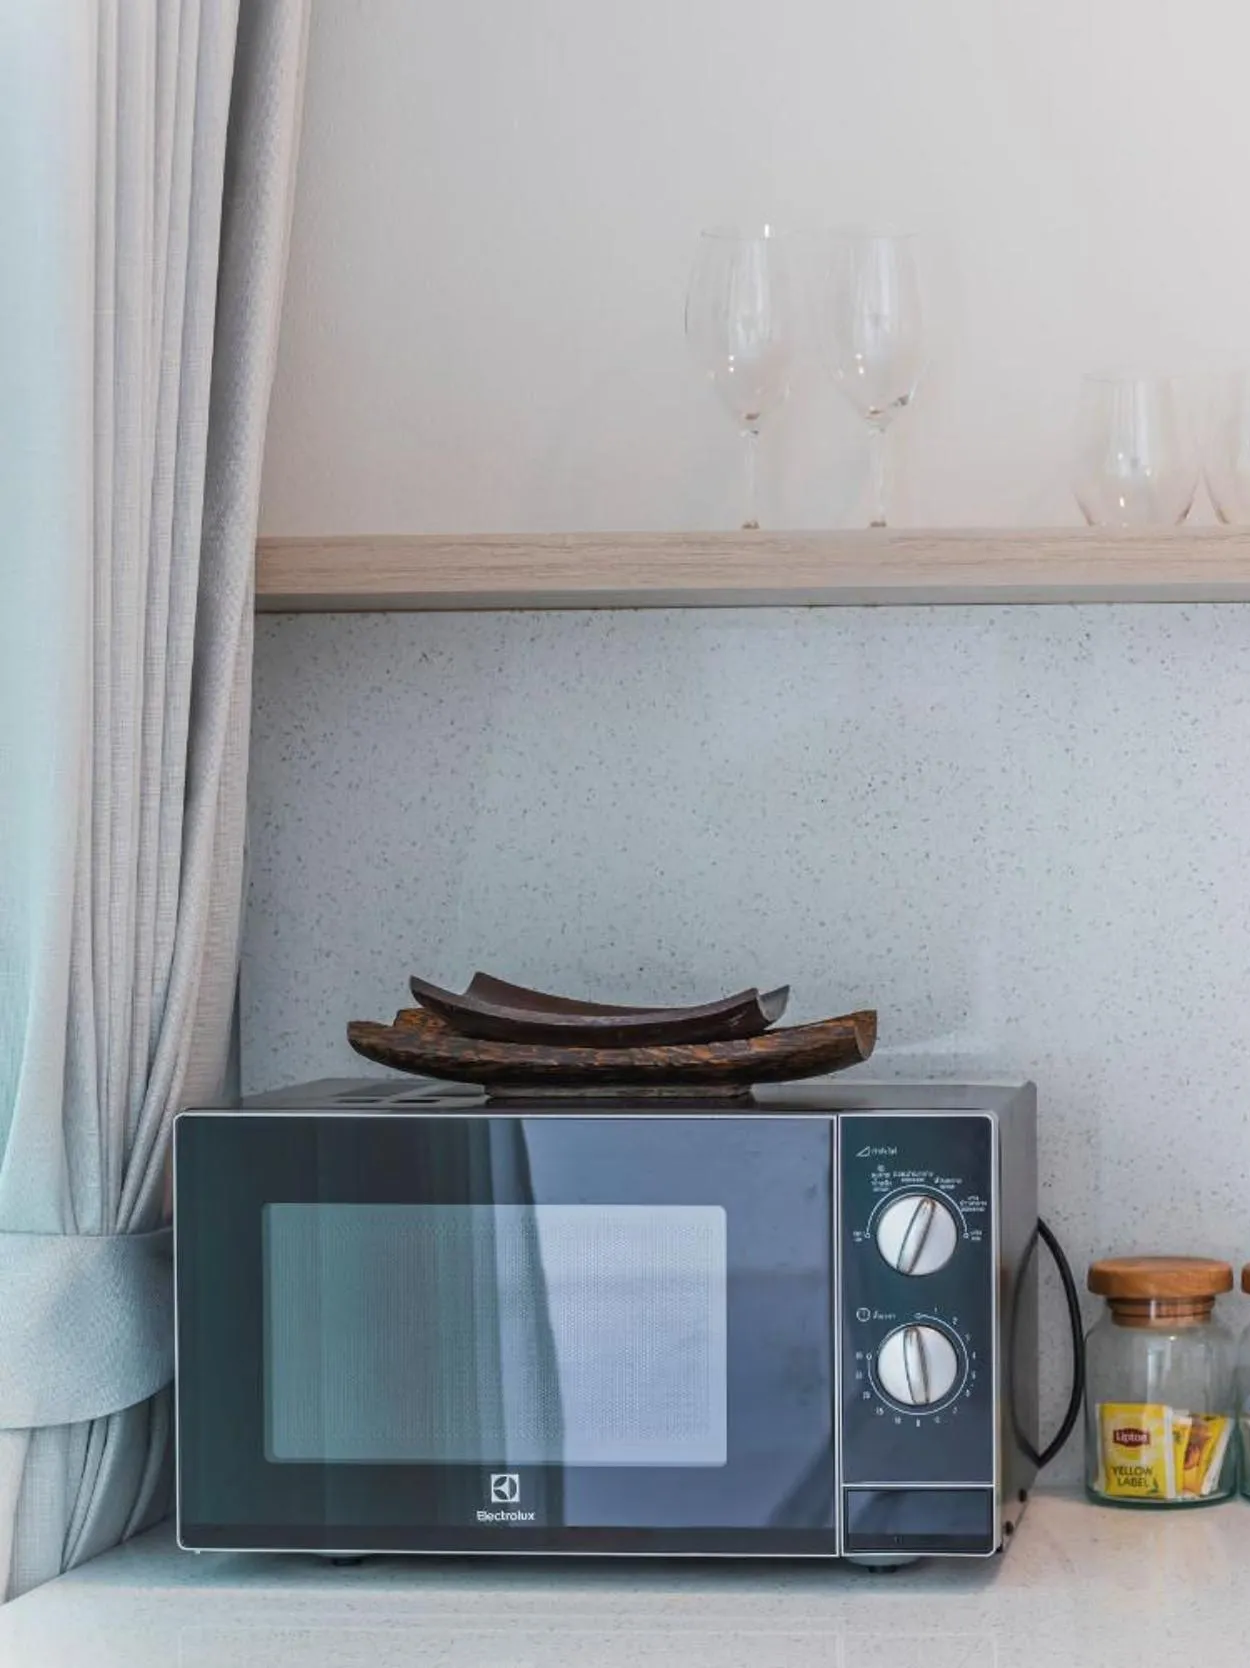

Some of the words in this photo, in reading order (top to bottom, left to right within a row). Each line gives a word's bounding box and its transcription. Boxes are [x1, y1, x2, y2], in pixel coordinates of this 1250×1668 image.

[1115, 1431, 1148, 1444] Lipton
[1110, 1466, 1153, 1476] YELLOW
[1117, 1477, 1150, 1488] LABEL
[476, 1510, 535, 1521] Electrolux
